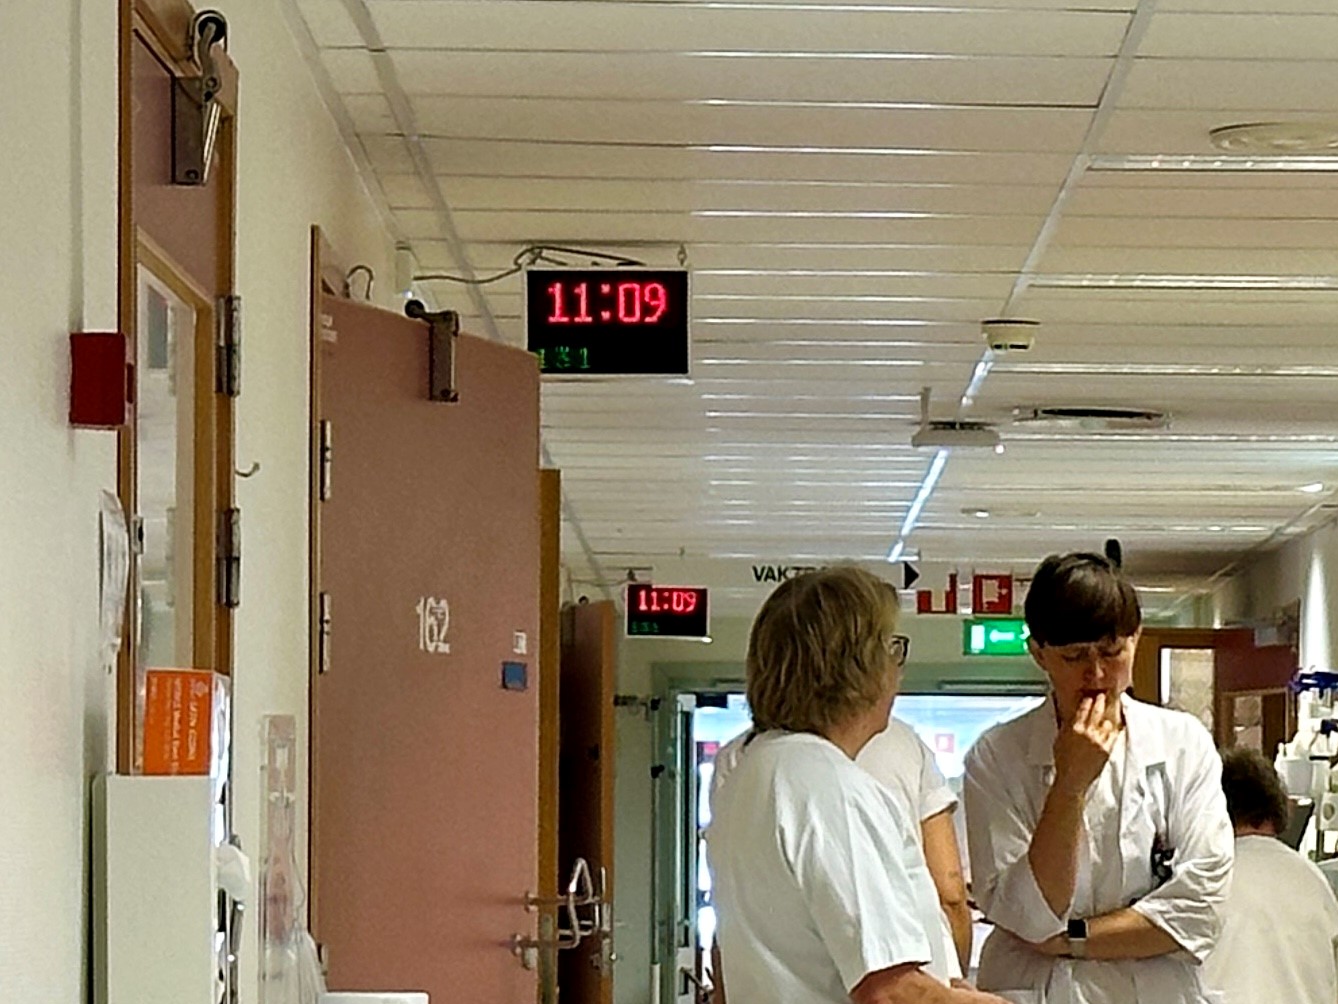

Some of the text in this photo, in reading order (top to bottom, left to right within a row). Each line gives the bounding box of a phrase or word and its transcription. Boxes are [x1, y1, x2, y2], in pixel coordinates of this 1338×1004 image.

[547, 281, 668, 324] 11:09
[638, 589, 697, 612] 11:09
[416, 596, 450, 653] 162
